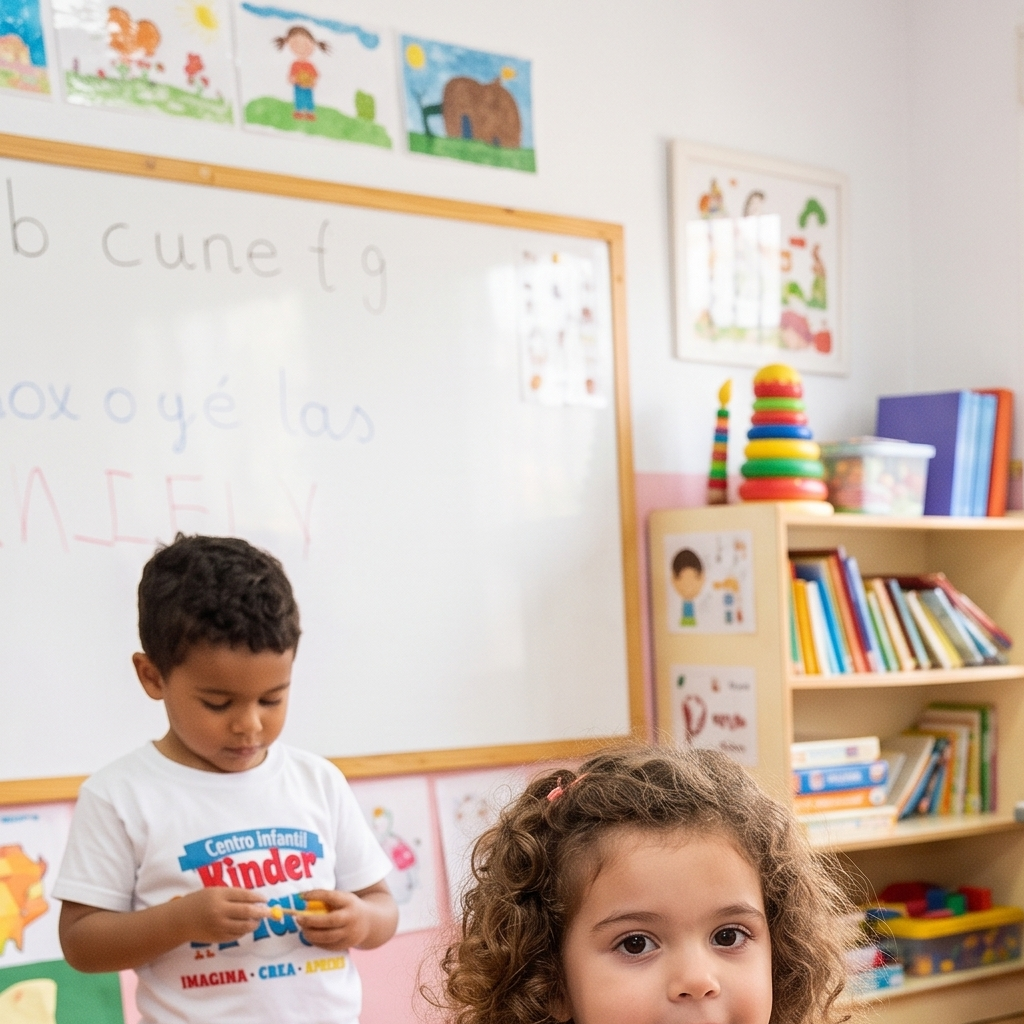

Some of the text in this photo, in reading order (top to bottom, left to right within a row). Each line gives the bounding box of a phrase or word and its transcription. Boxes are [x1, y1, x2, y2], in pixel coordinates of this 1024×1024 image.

[6, 177, 50, 259] b
[360, 243, 389, 316] g
[204, 829, 308, 857] Centro infantil
[196, 847, 316, 889] Kinder
[181, 969, 248, 990] IMAGINA
[258, 963, 297, 980] CREA
